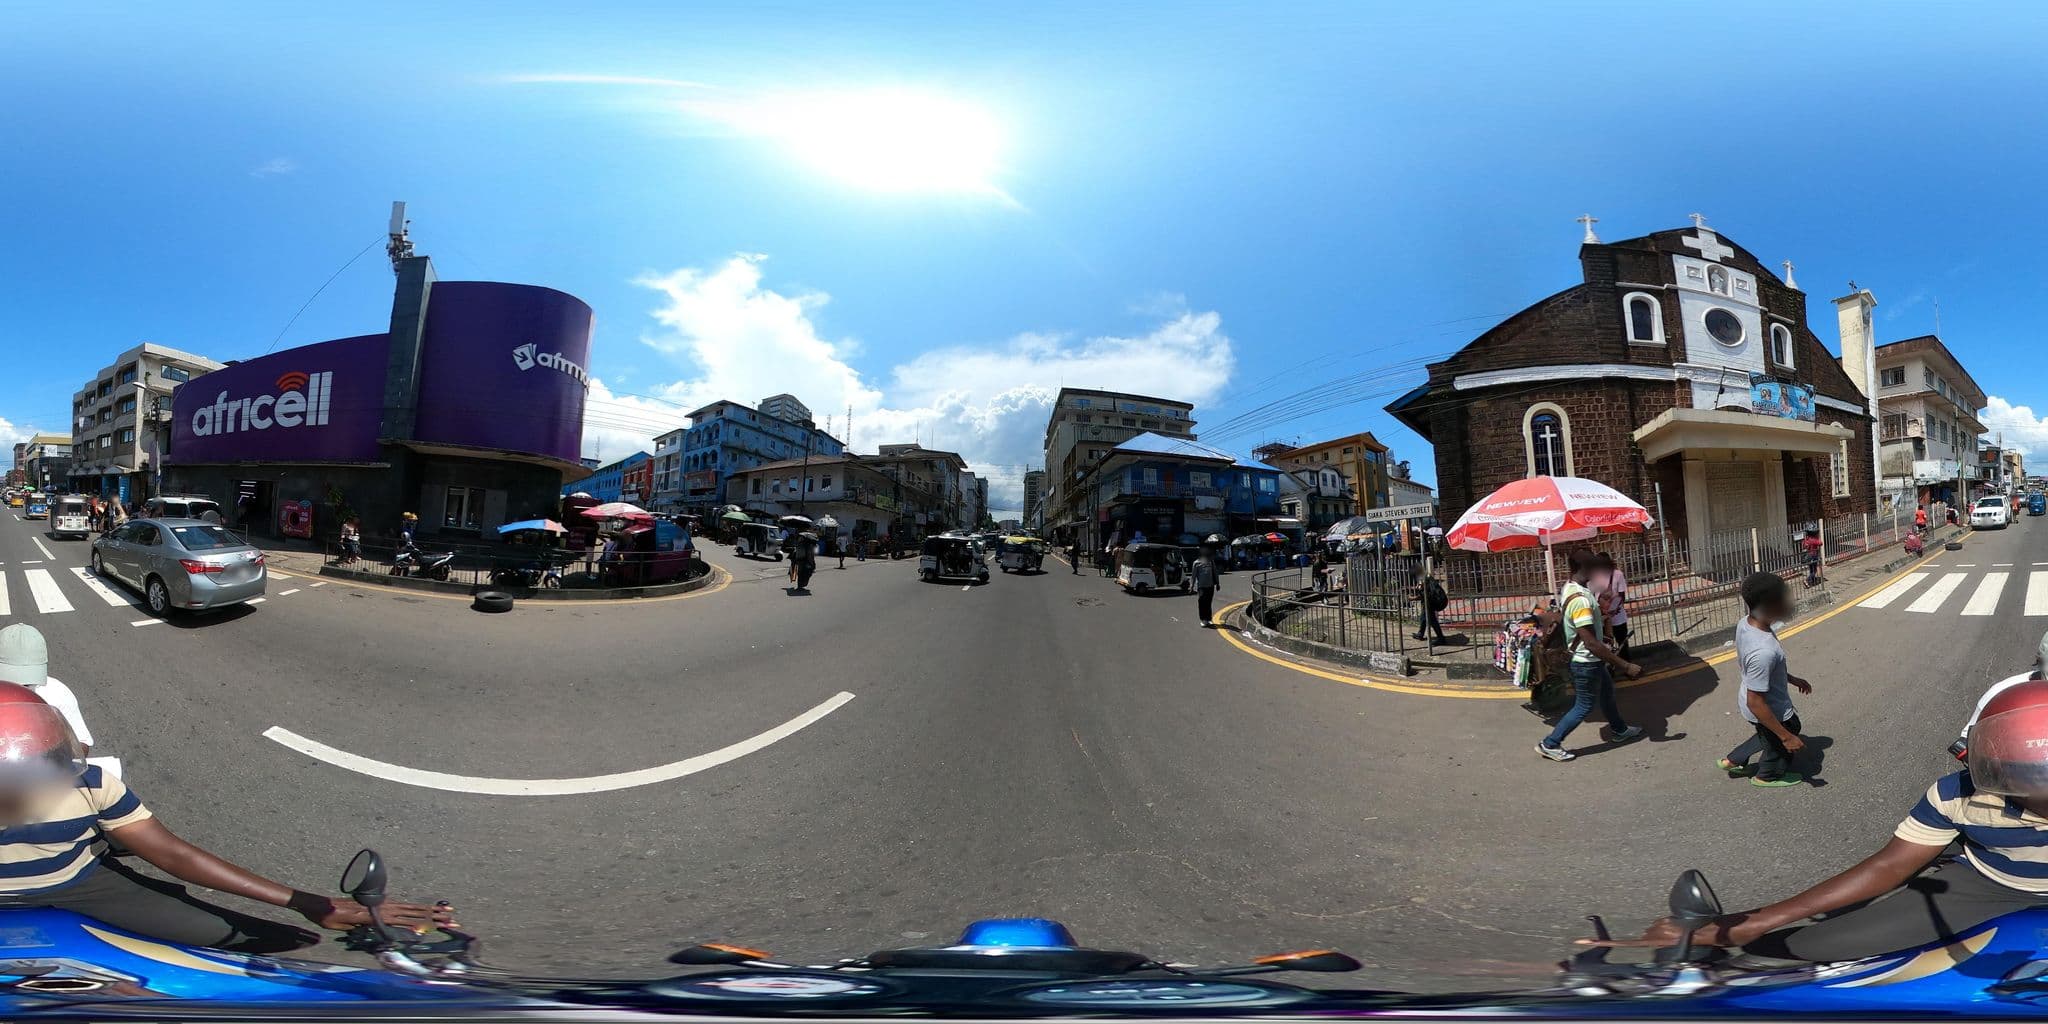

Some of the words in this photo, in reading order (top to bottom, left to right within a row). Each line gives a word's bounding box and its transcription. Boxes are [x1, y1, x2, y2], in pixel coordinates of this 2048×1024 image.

[192, 371, 333, 437] africell
[1368, 511, 1383, 519] SIAKA
[1385, 508, 1408, 517] STEVENS
[1410, 506, 1430, 515] STREET
